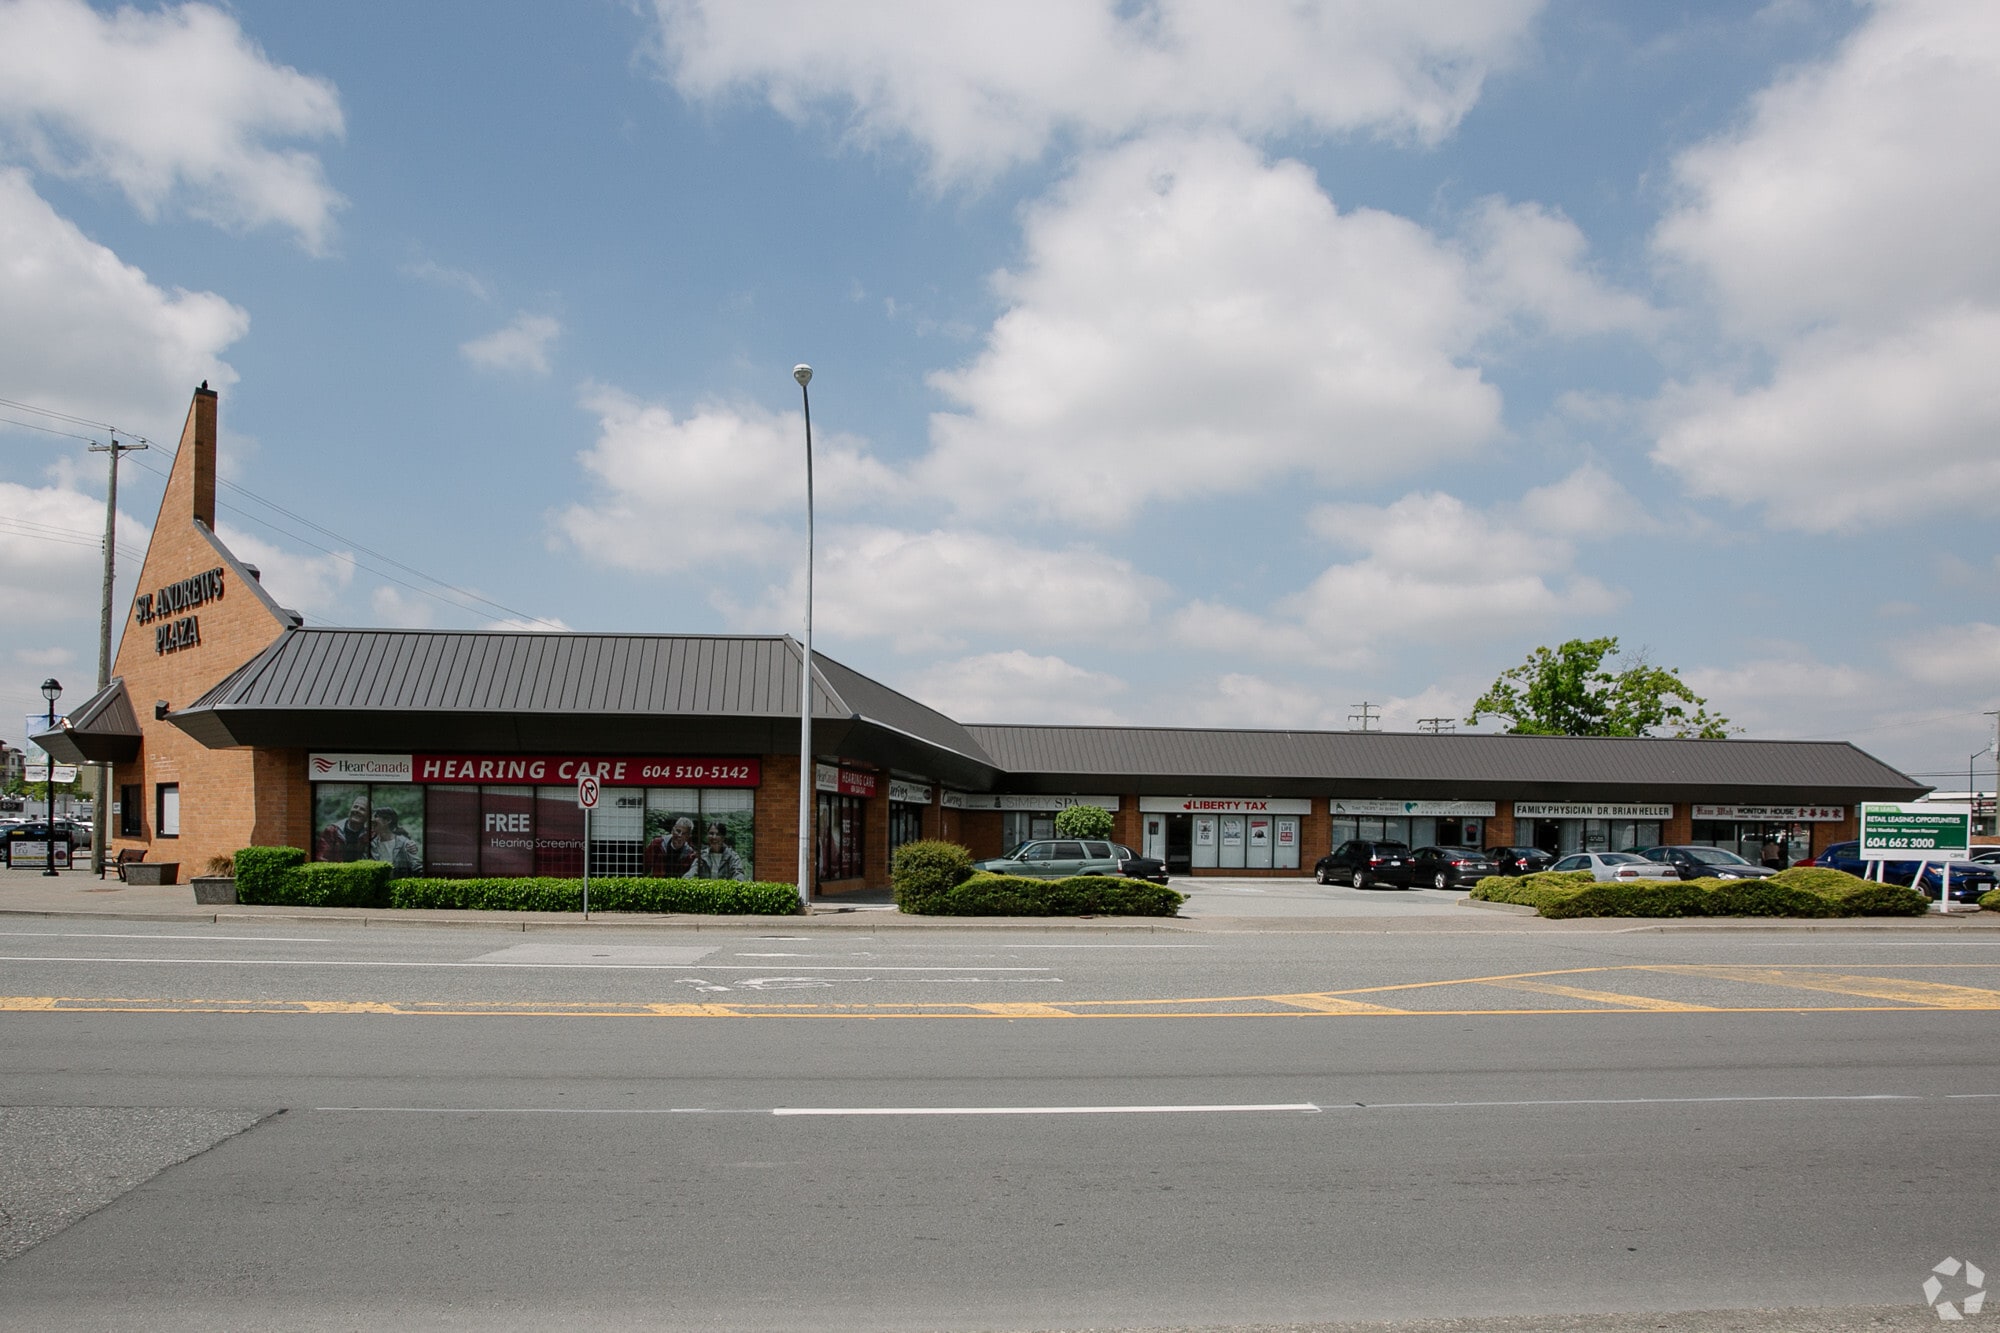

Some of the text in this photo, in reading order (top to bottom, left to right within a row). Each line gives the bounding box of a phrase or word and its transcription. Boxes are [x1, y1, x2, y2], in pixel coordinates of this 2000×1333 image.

[135, 567, 224, 623] ST. ANDREWS
[155, 615, 199, 653] PLAZA
[339, 760, 409, 773] HearCanada
[423, 760, 749, 780] HEARING CARE 604 510-5142
[1006, 796, 1079, 808] SIMPLY SPA
[1193, 801, 1267, 810] LIBERTY TAX
[1516, 805, 1669, 816] FAMILY PHYSICIAN DR. BRIAN HELLER
[1737, 807, 1767, 815] WONTON
[1770, 807, 1794, 815] HOUSE
[485, 813, 530, 832] FREE
[1867, 815, 1887, 823] RETAIL
[1915, 816, 1961, 824] OPPORTUNITIES
[491, 838, 587, 850] Hearing Screening
[1866, 838, 1935, 848] 604 662 3000
